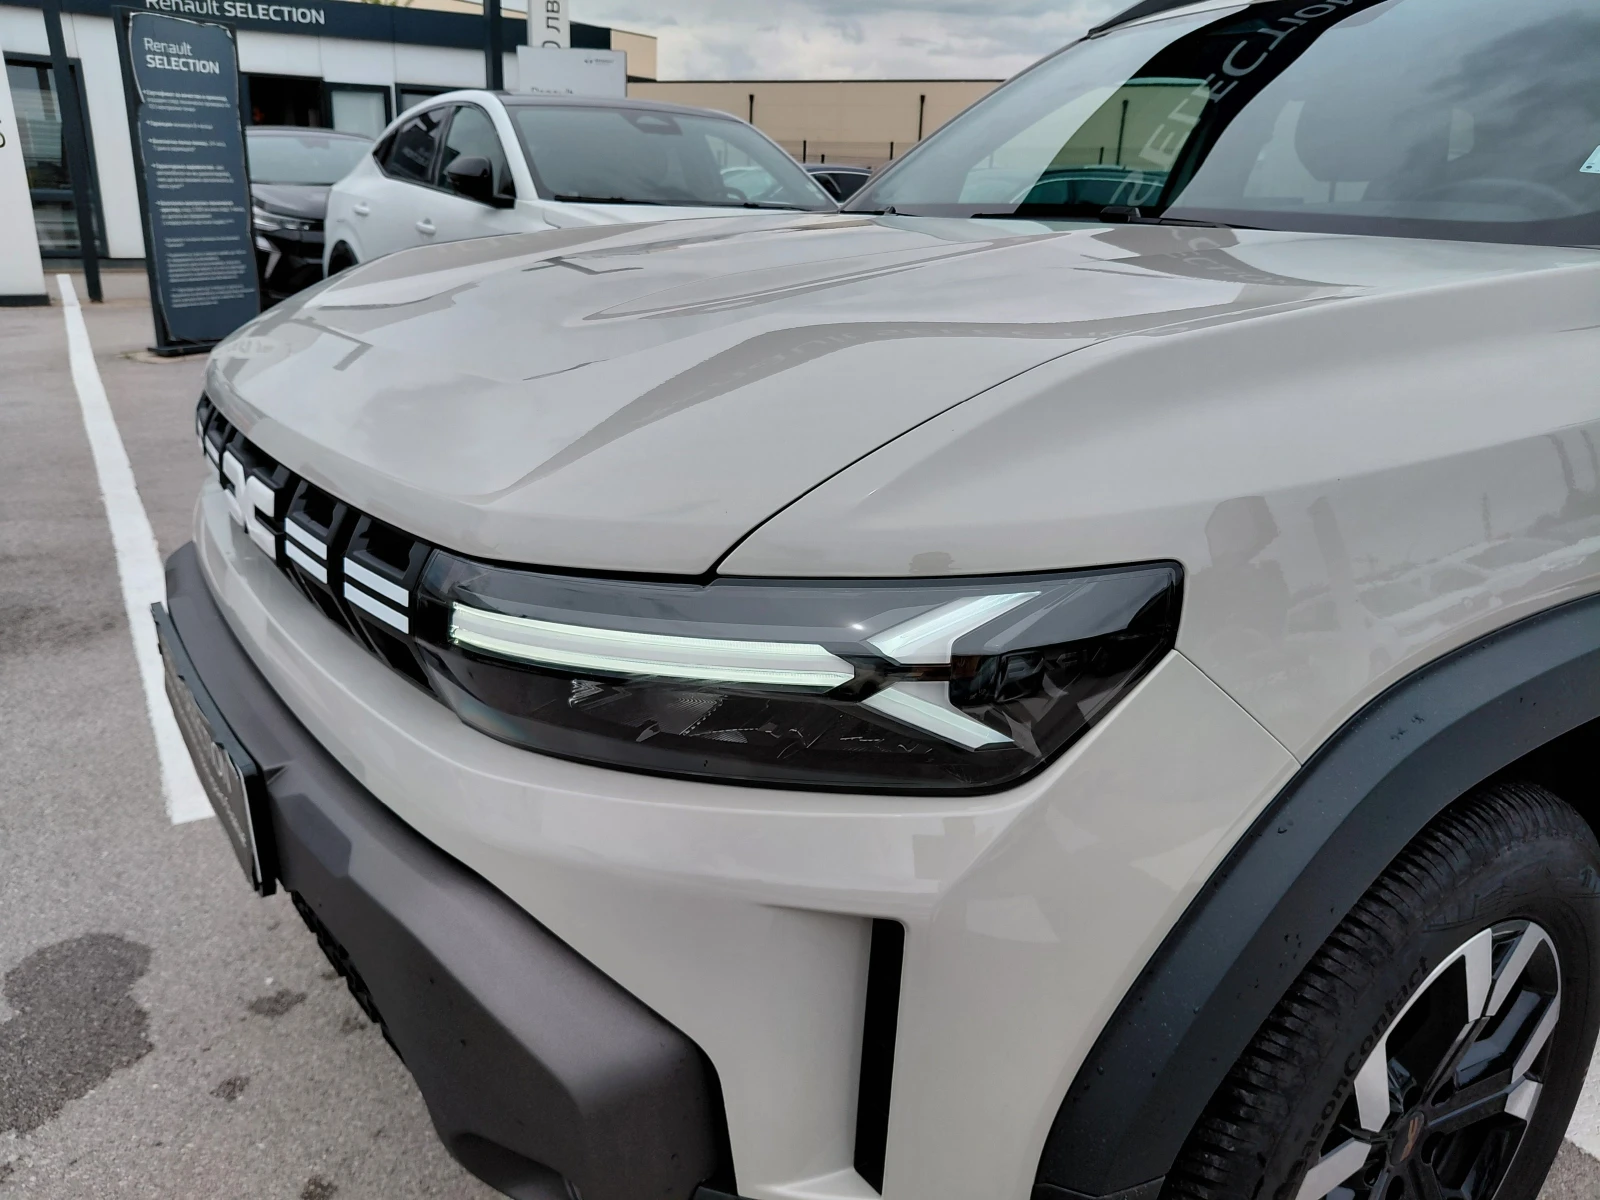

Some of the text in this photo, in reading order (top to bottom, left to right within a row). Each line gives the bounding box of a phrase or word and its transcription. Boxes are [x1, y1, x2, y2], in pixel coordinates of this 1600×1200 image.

[146, 0, 326, 25] Renault SELECTION
[143, 37, 193, 57] Renault
[145, 54, 220, 75] SELECTION
